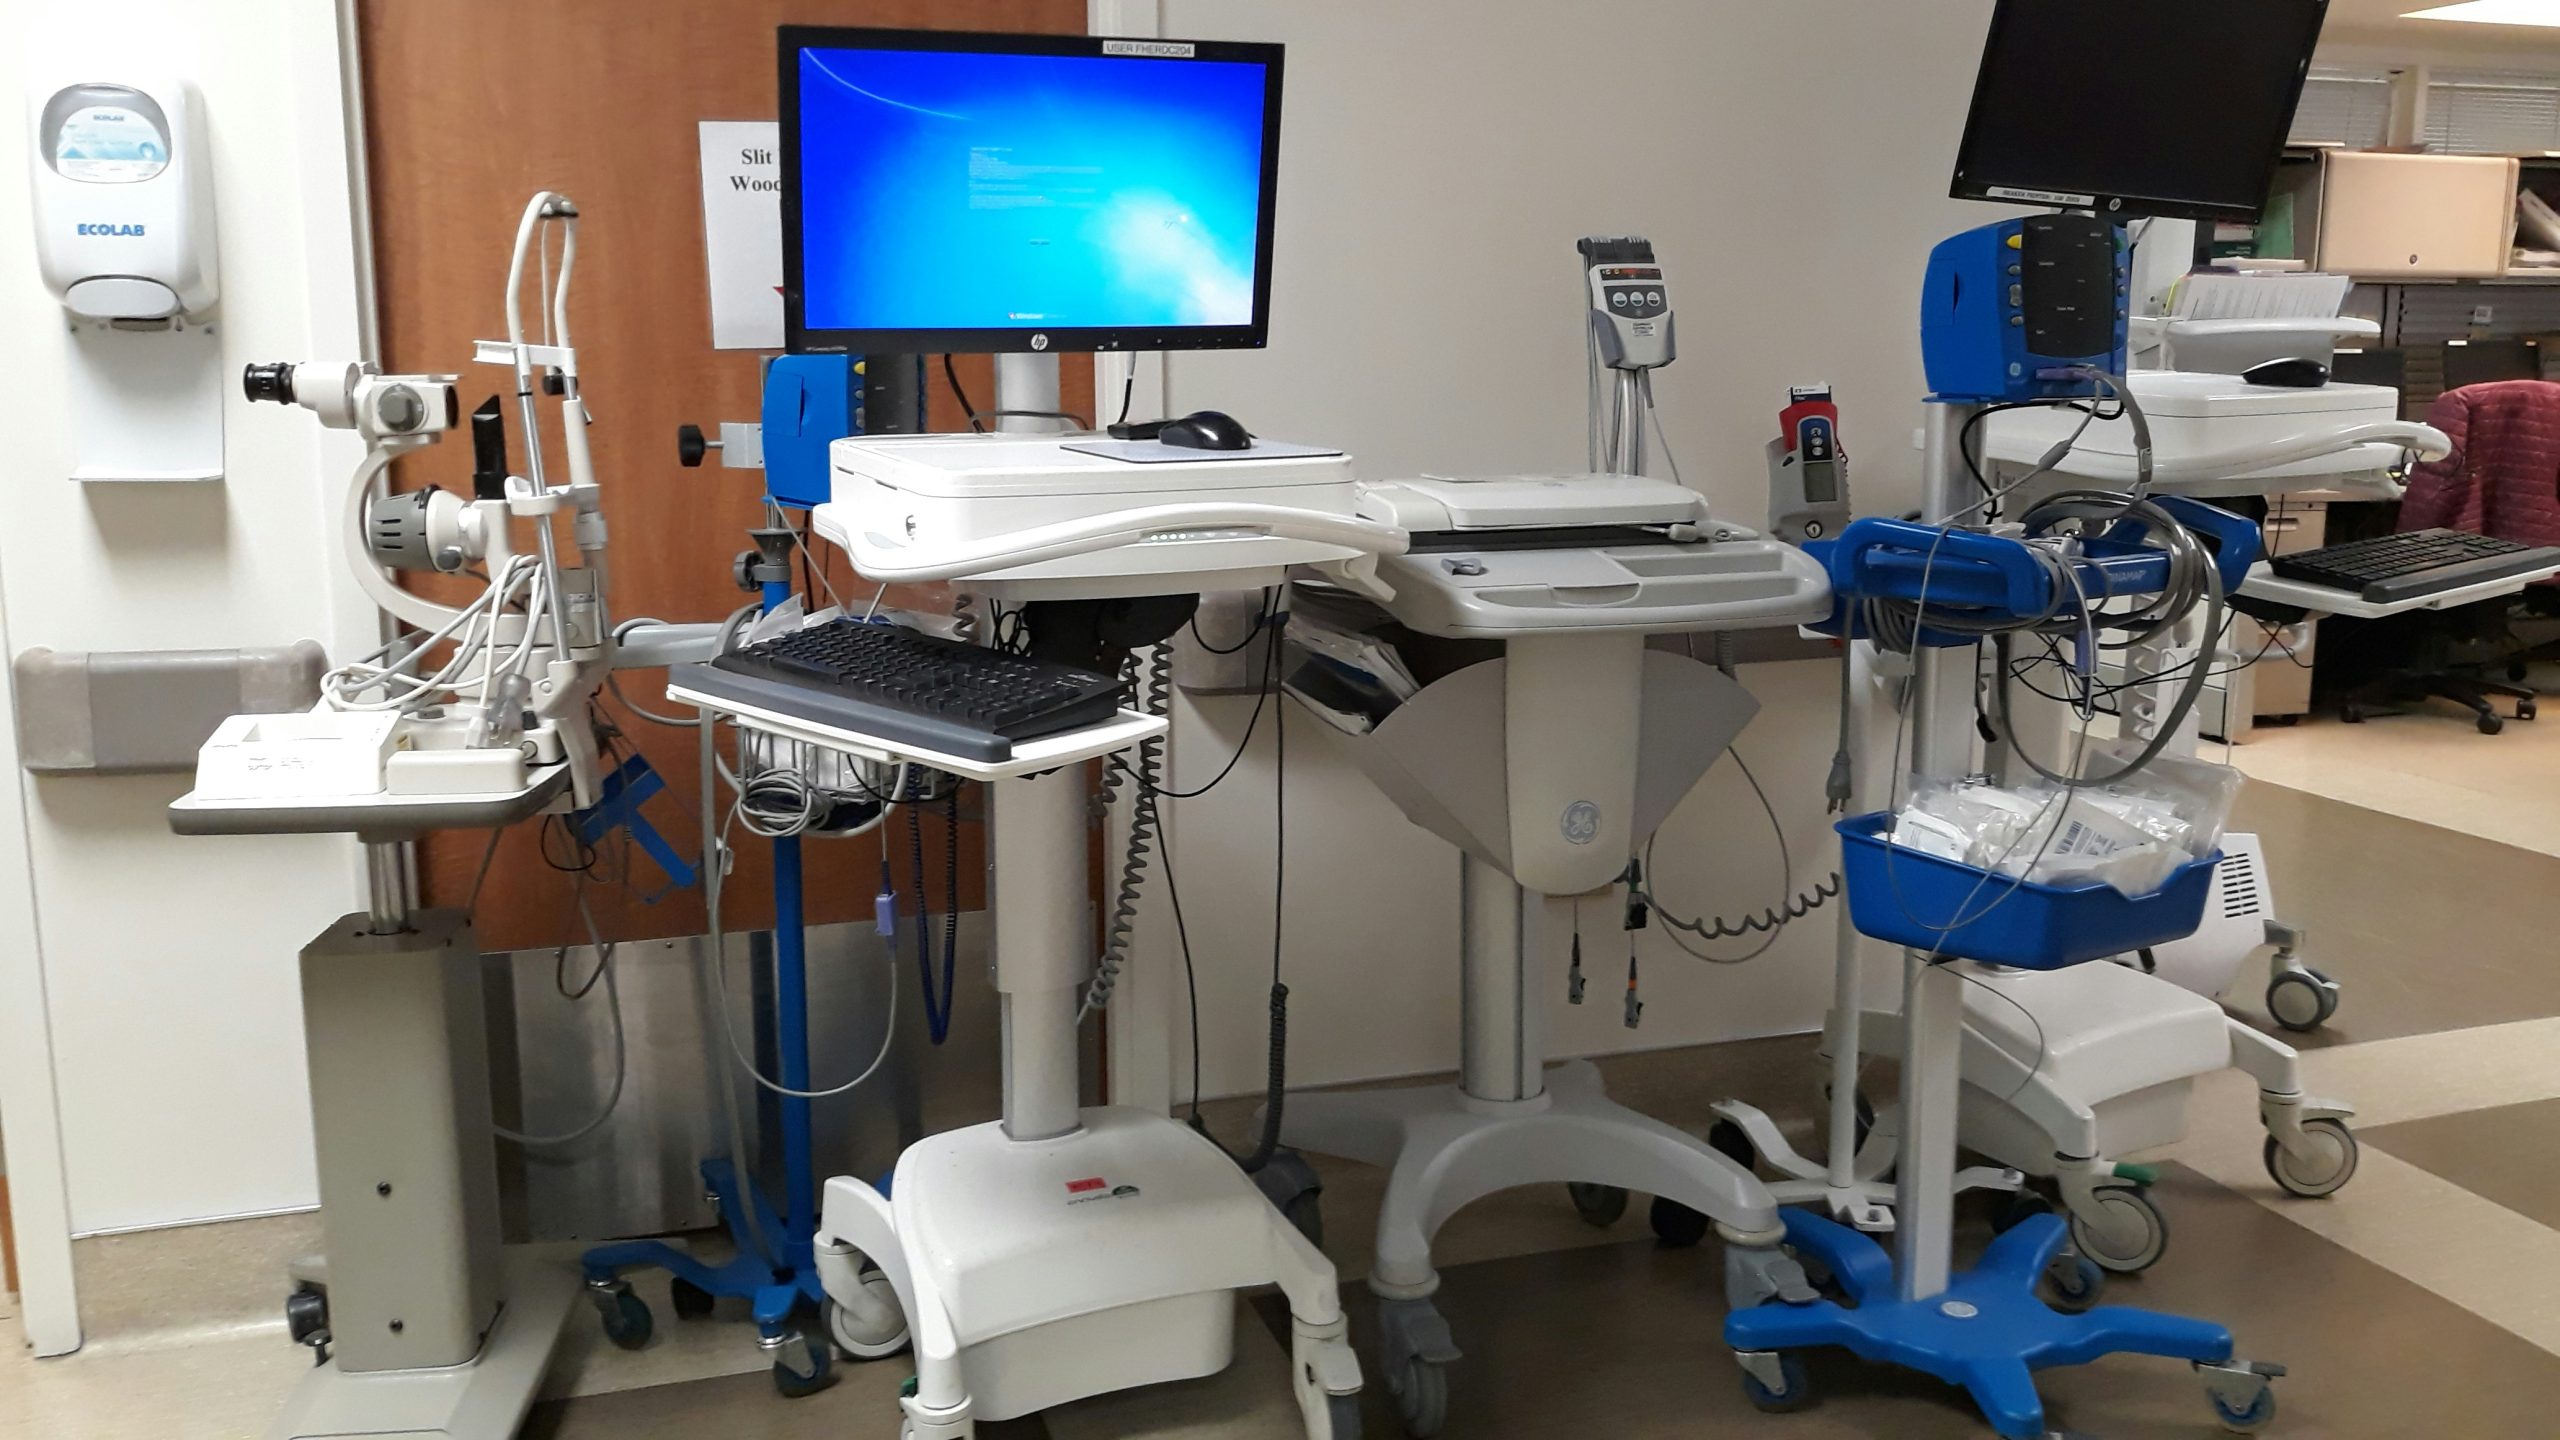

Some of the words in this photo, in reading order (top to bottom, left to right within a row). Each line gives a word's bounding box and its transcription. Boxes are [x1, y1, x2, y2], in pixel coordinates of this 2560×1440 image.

[741, 148, 772, 165] Slit
[77, 223, 145, 237] ECOLAB
[1031, 333, 1049, 351] hp
